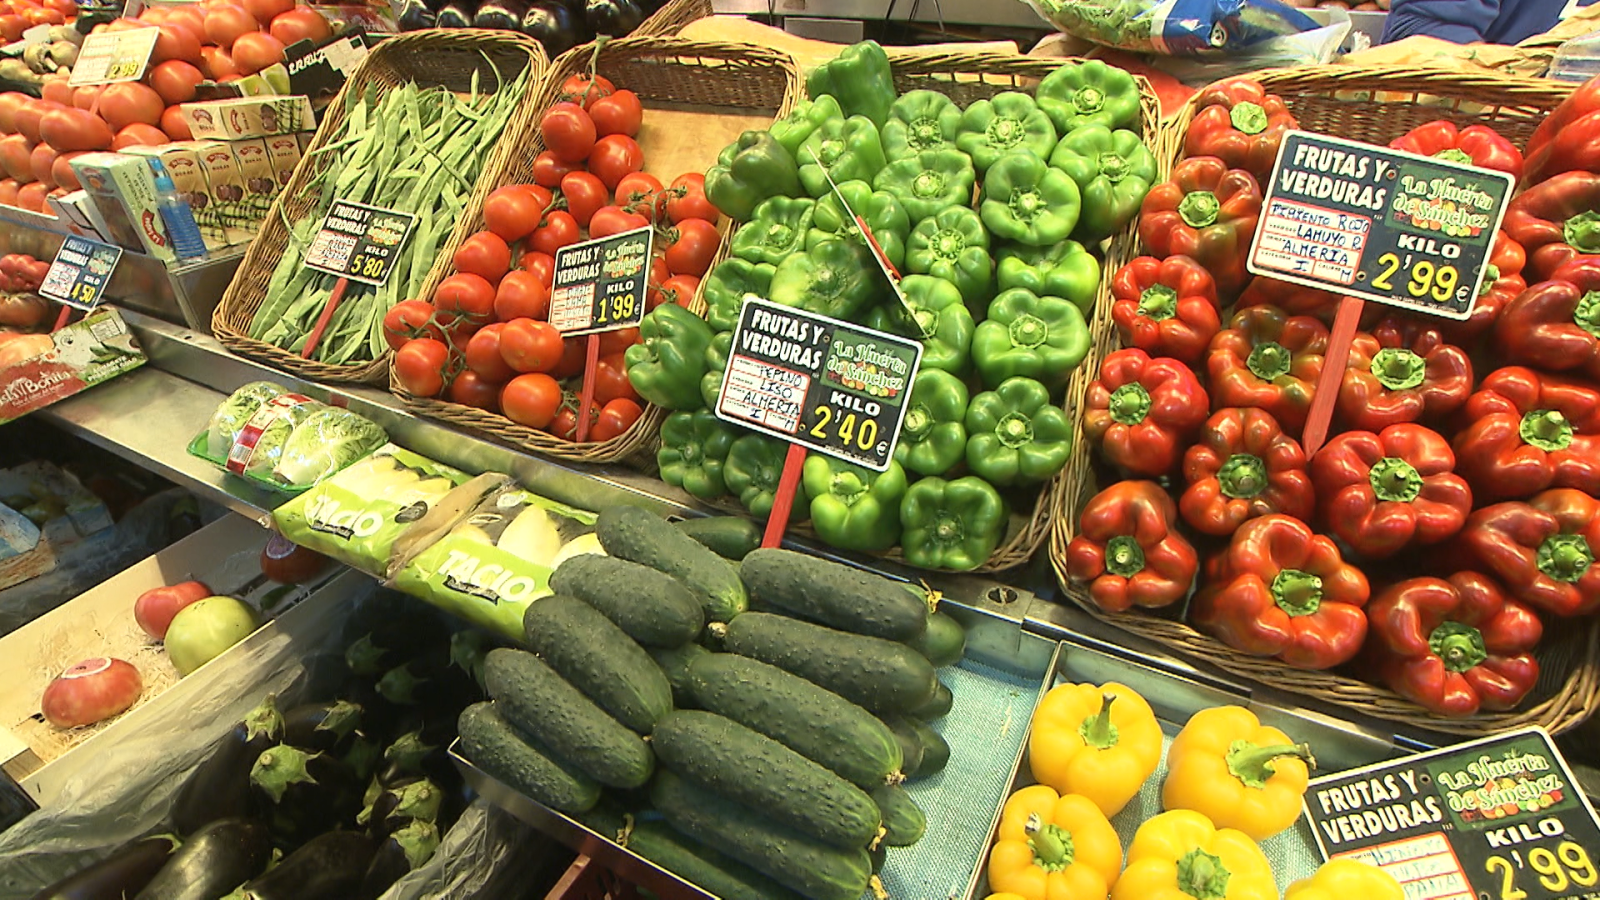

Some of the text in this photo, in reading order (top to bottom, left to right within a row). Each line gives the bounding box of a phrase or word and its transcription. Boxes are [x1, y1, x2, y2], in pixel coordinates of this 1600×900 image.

[1293, 144, 1391, 182] FRUTAS Y
[1281, 169, 1386, 210] VERDURAS
[1401, 176, 1494, 210] La Huerta
[334, 205, 371, 222] FRUTAS Y
[1393, 192, 1415, 214] de
[326, 216, 367, 235] VERDURAS
[1271, 203, 1370, 234] PIMIENTO ROJO
[365, 245, 388, 256] KILO
[562, 246, 600, 268] FRUTAS Y
[1282, 240, 1348, 266] ALMERIA
[1398, 234, 1460, 258] KILO
[558, 263, 600, 284] VERDURAS
[606, 280, 634, 294] KILO
[751, 309, 825, 346] FRUTAS Y
[742, 330, 822, 370] VERDURAS
[834, 340, 907, 374] La Huerta
[760, 367, 802, 387] PEPINO
[827, 357, 846, 372] de
[760, 378, 793, 399] LISO
[742, 391, 801, 418] ALMERIA
[830, 391, 880, 417] KILO
[438, 550, 536, 602] TACIO
[1438, 754, 1550, 791] La Huerta
[1317, 769, 1420, 815] FRUTAS Y
[1448, 791, 1476, 812] de
[1321, 796, 1443, 844] VERDURAS
[1485, 818, 1565, 848] KILO
